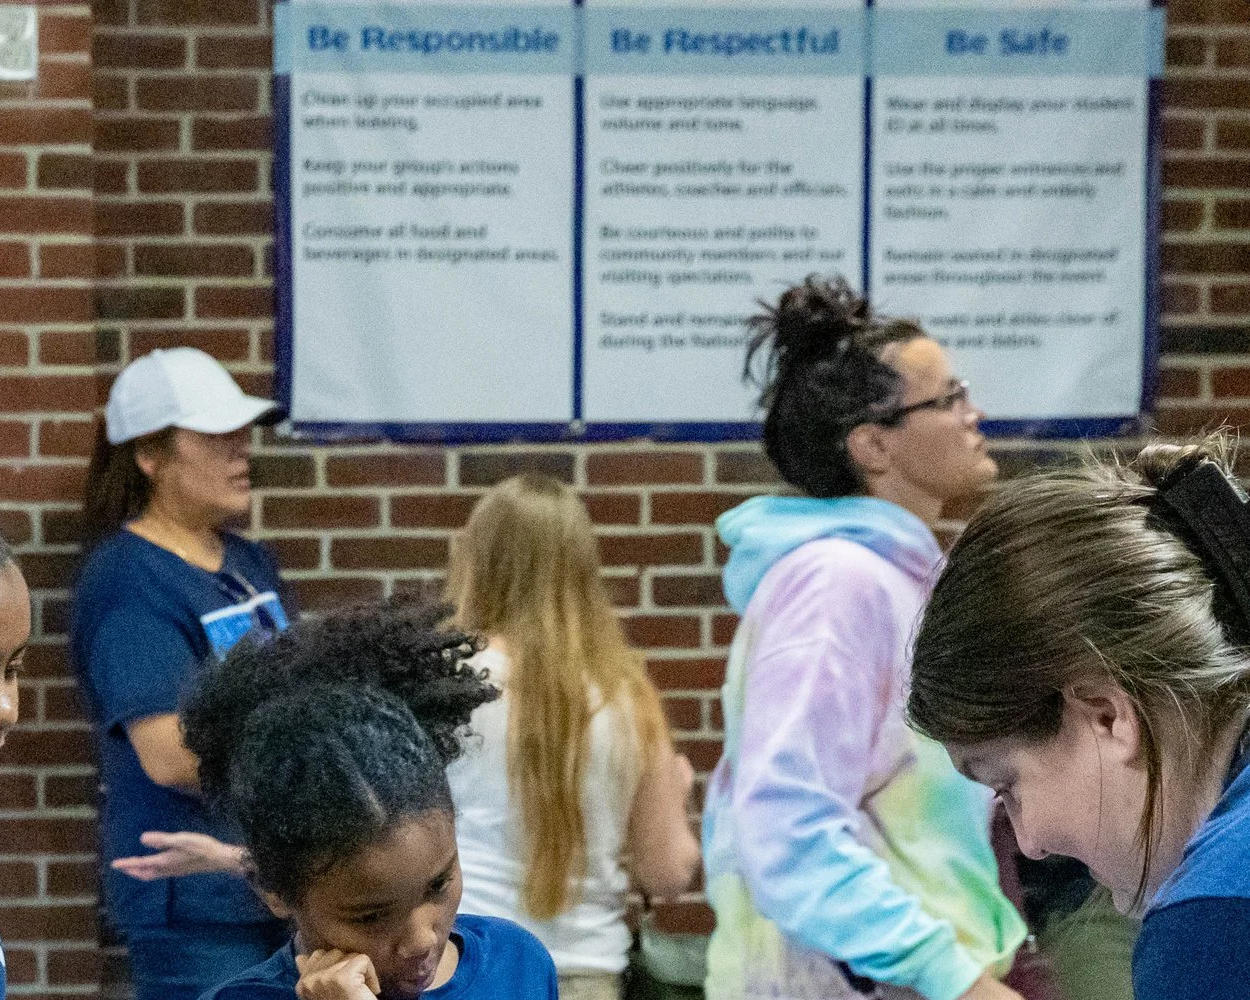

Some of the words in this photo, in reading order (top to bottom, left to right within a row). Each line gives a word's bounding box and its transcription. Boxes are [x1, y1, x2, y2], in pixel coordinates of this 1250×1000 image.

[307, 26, 350, 52] Be
[361, 25, 560, 56] Responsible
[610, 28, 651, 54] Be
[663, 27, 840, 57] Respectful
[945, 29, 988, 55] Be
[998, 28, 1069, 55] Safe
